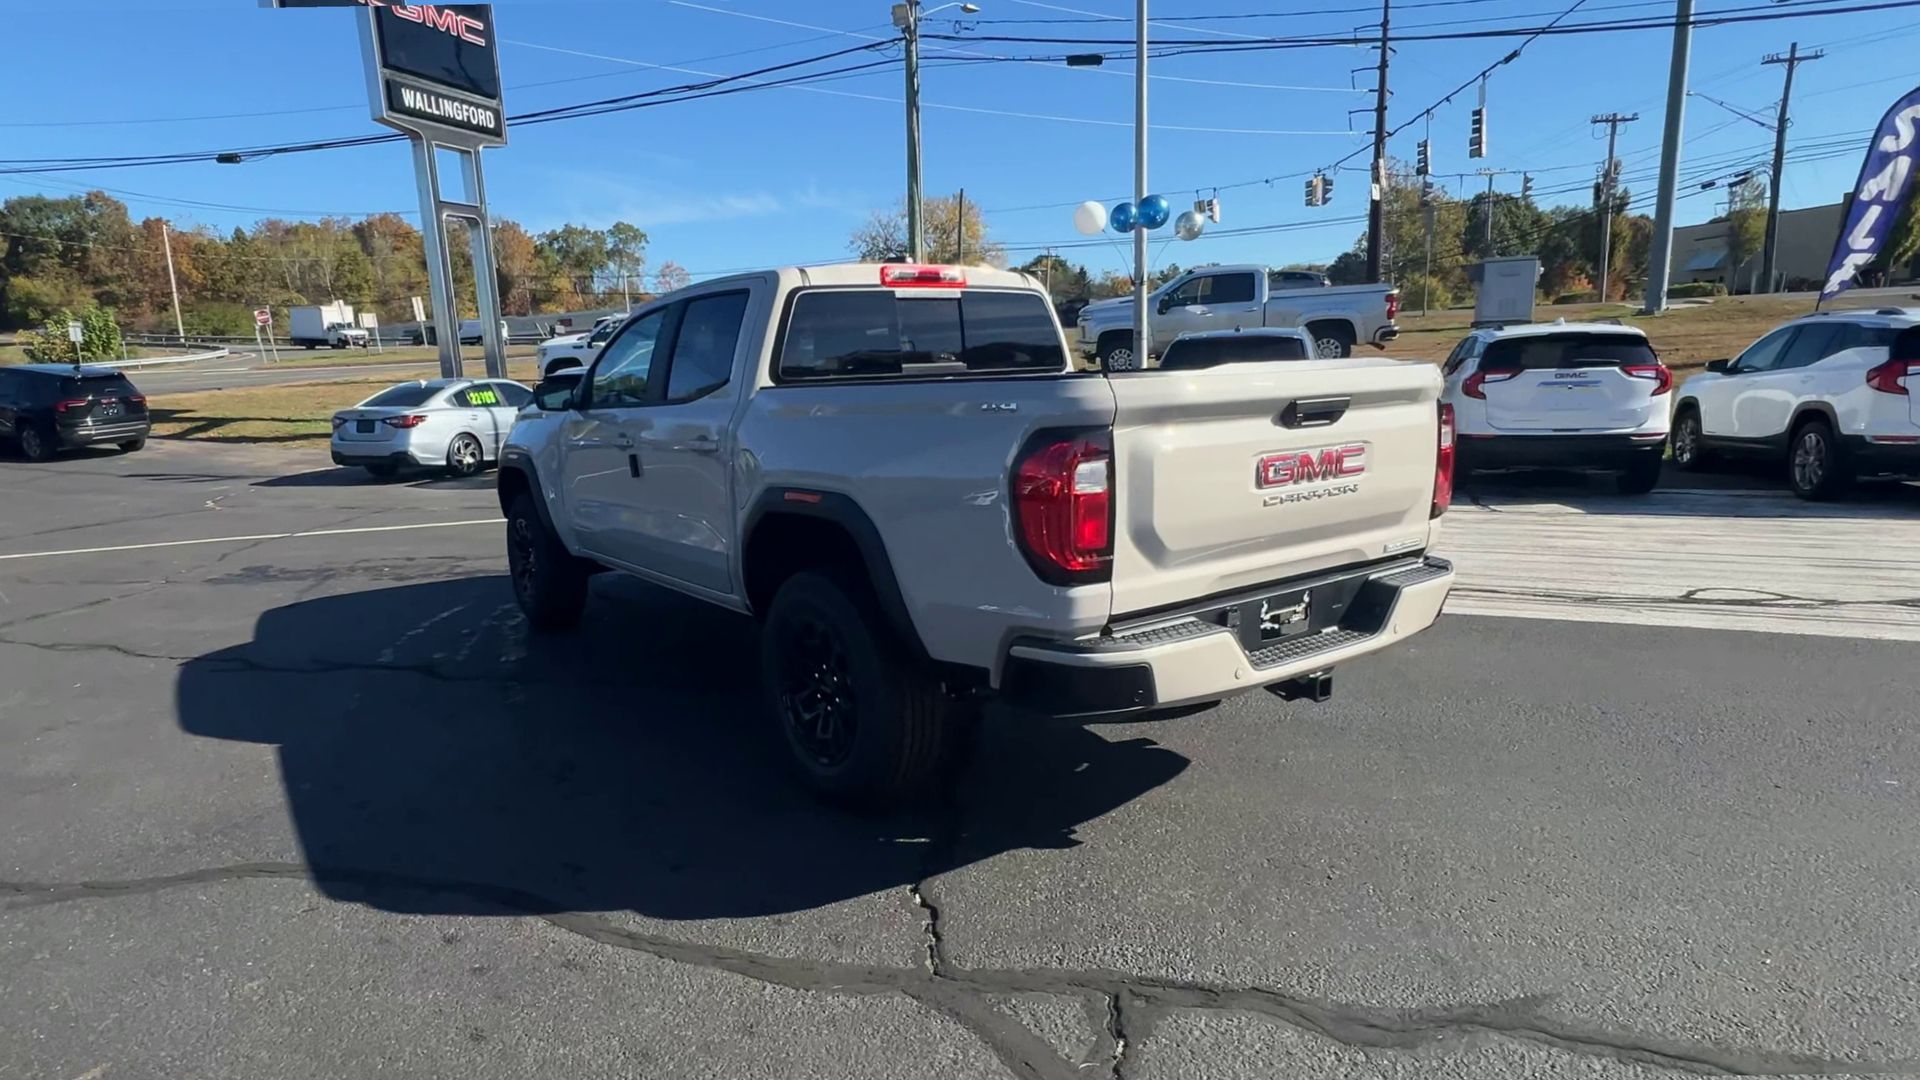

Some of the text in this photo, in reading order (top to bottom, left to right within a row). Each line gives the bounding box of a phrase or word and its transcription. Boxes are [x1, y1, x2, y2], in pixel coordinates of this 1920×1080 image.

[402, 87, 495, 129] WALLINGFORD
[1554, 371, 1589, 379] GMC
[1256, 443, 1366, 490] GMC
[1262, 483, 1358, 507] CANYON
